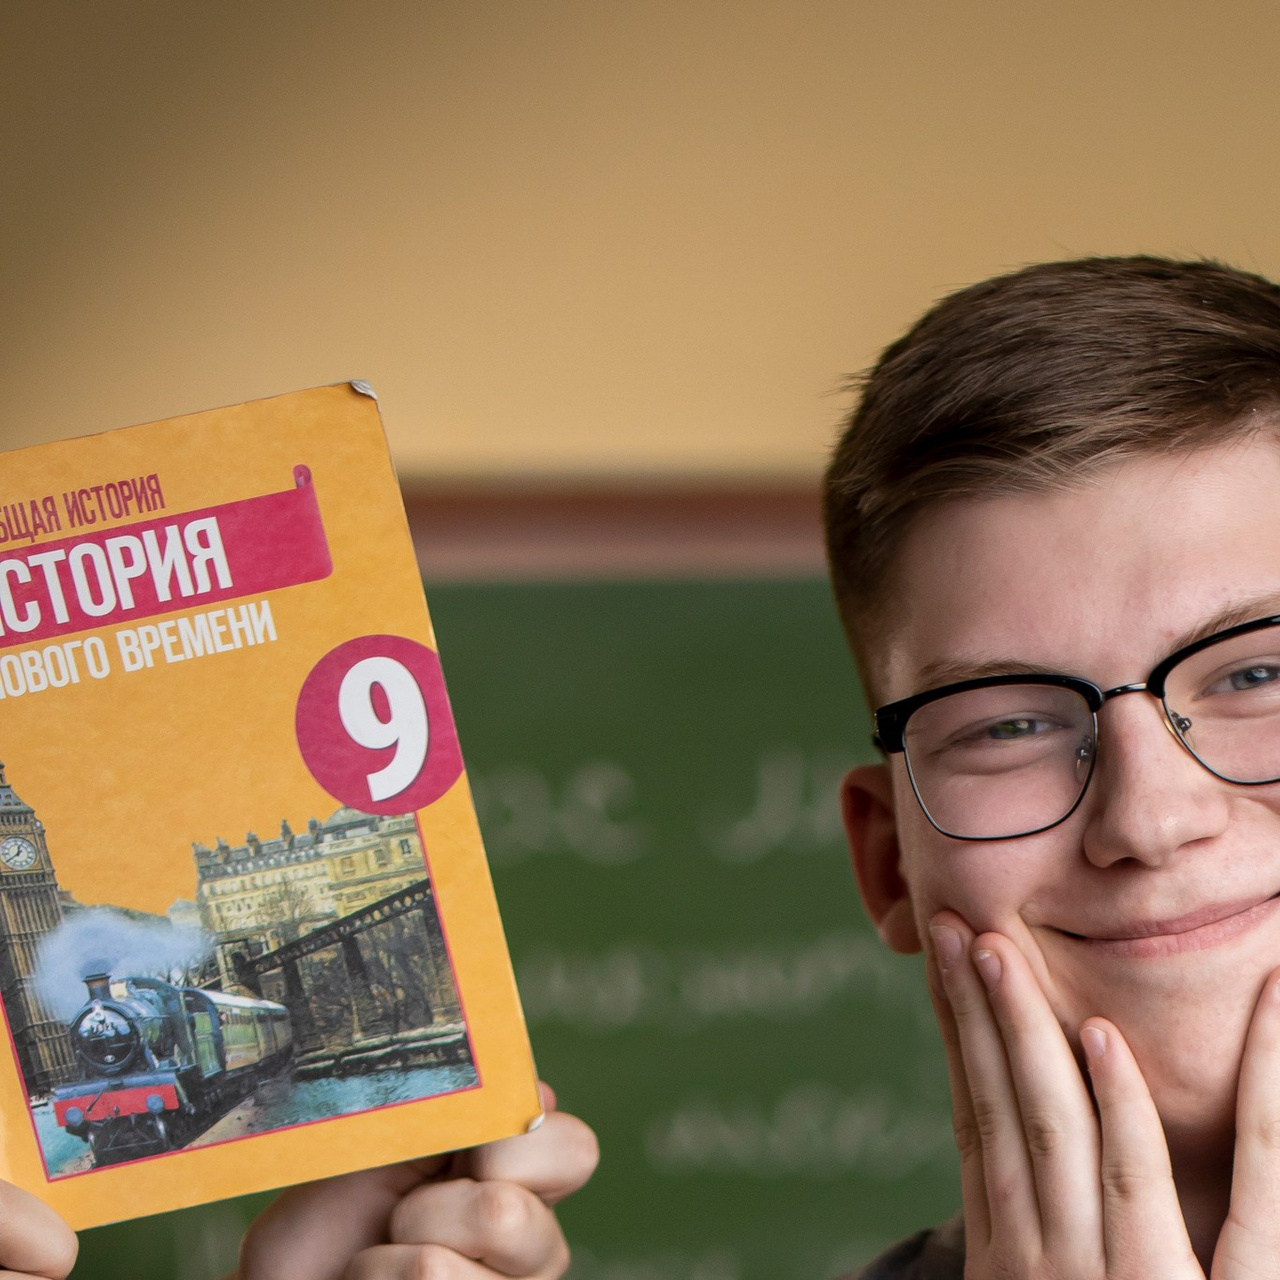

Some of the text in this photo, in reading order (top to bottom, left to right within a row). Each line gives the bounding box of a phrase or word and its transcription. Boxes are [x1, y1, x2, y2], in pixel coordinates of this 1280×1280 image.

[62, 473, 166, 529] ИСТОРИЯ
[0, 516, 233, 637] СТОРИЯ
[0, 600, 278, 701] ОВОГО ВРЕМЕНИ
[337, 655, 430, 802] 9
